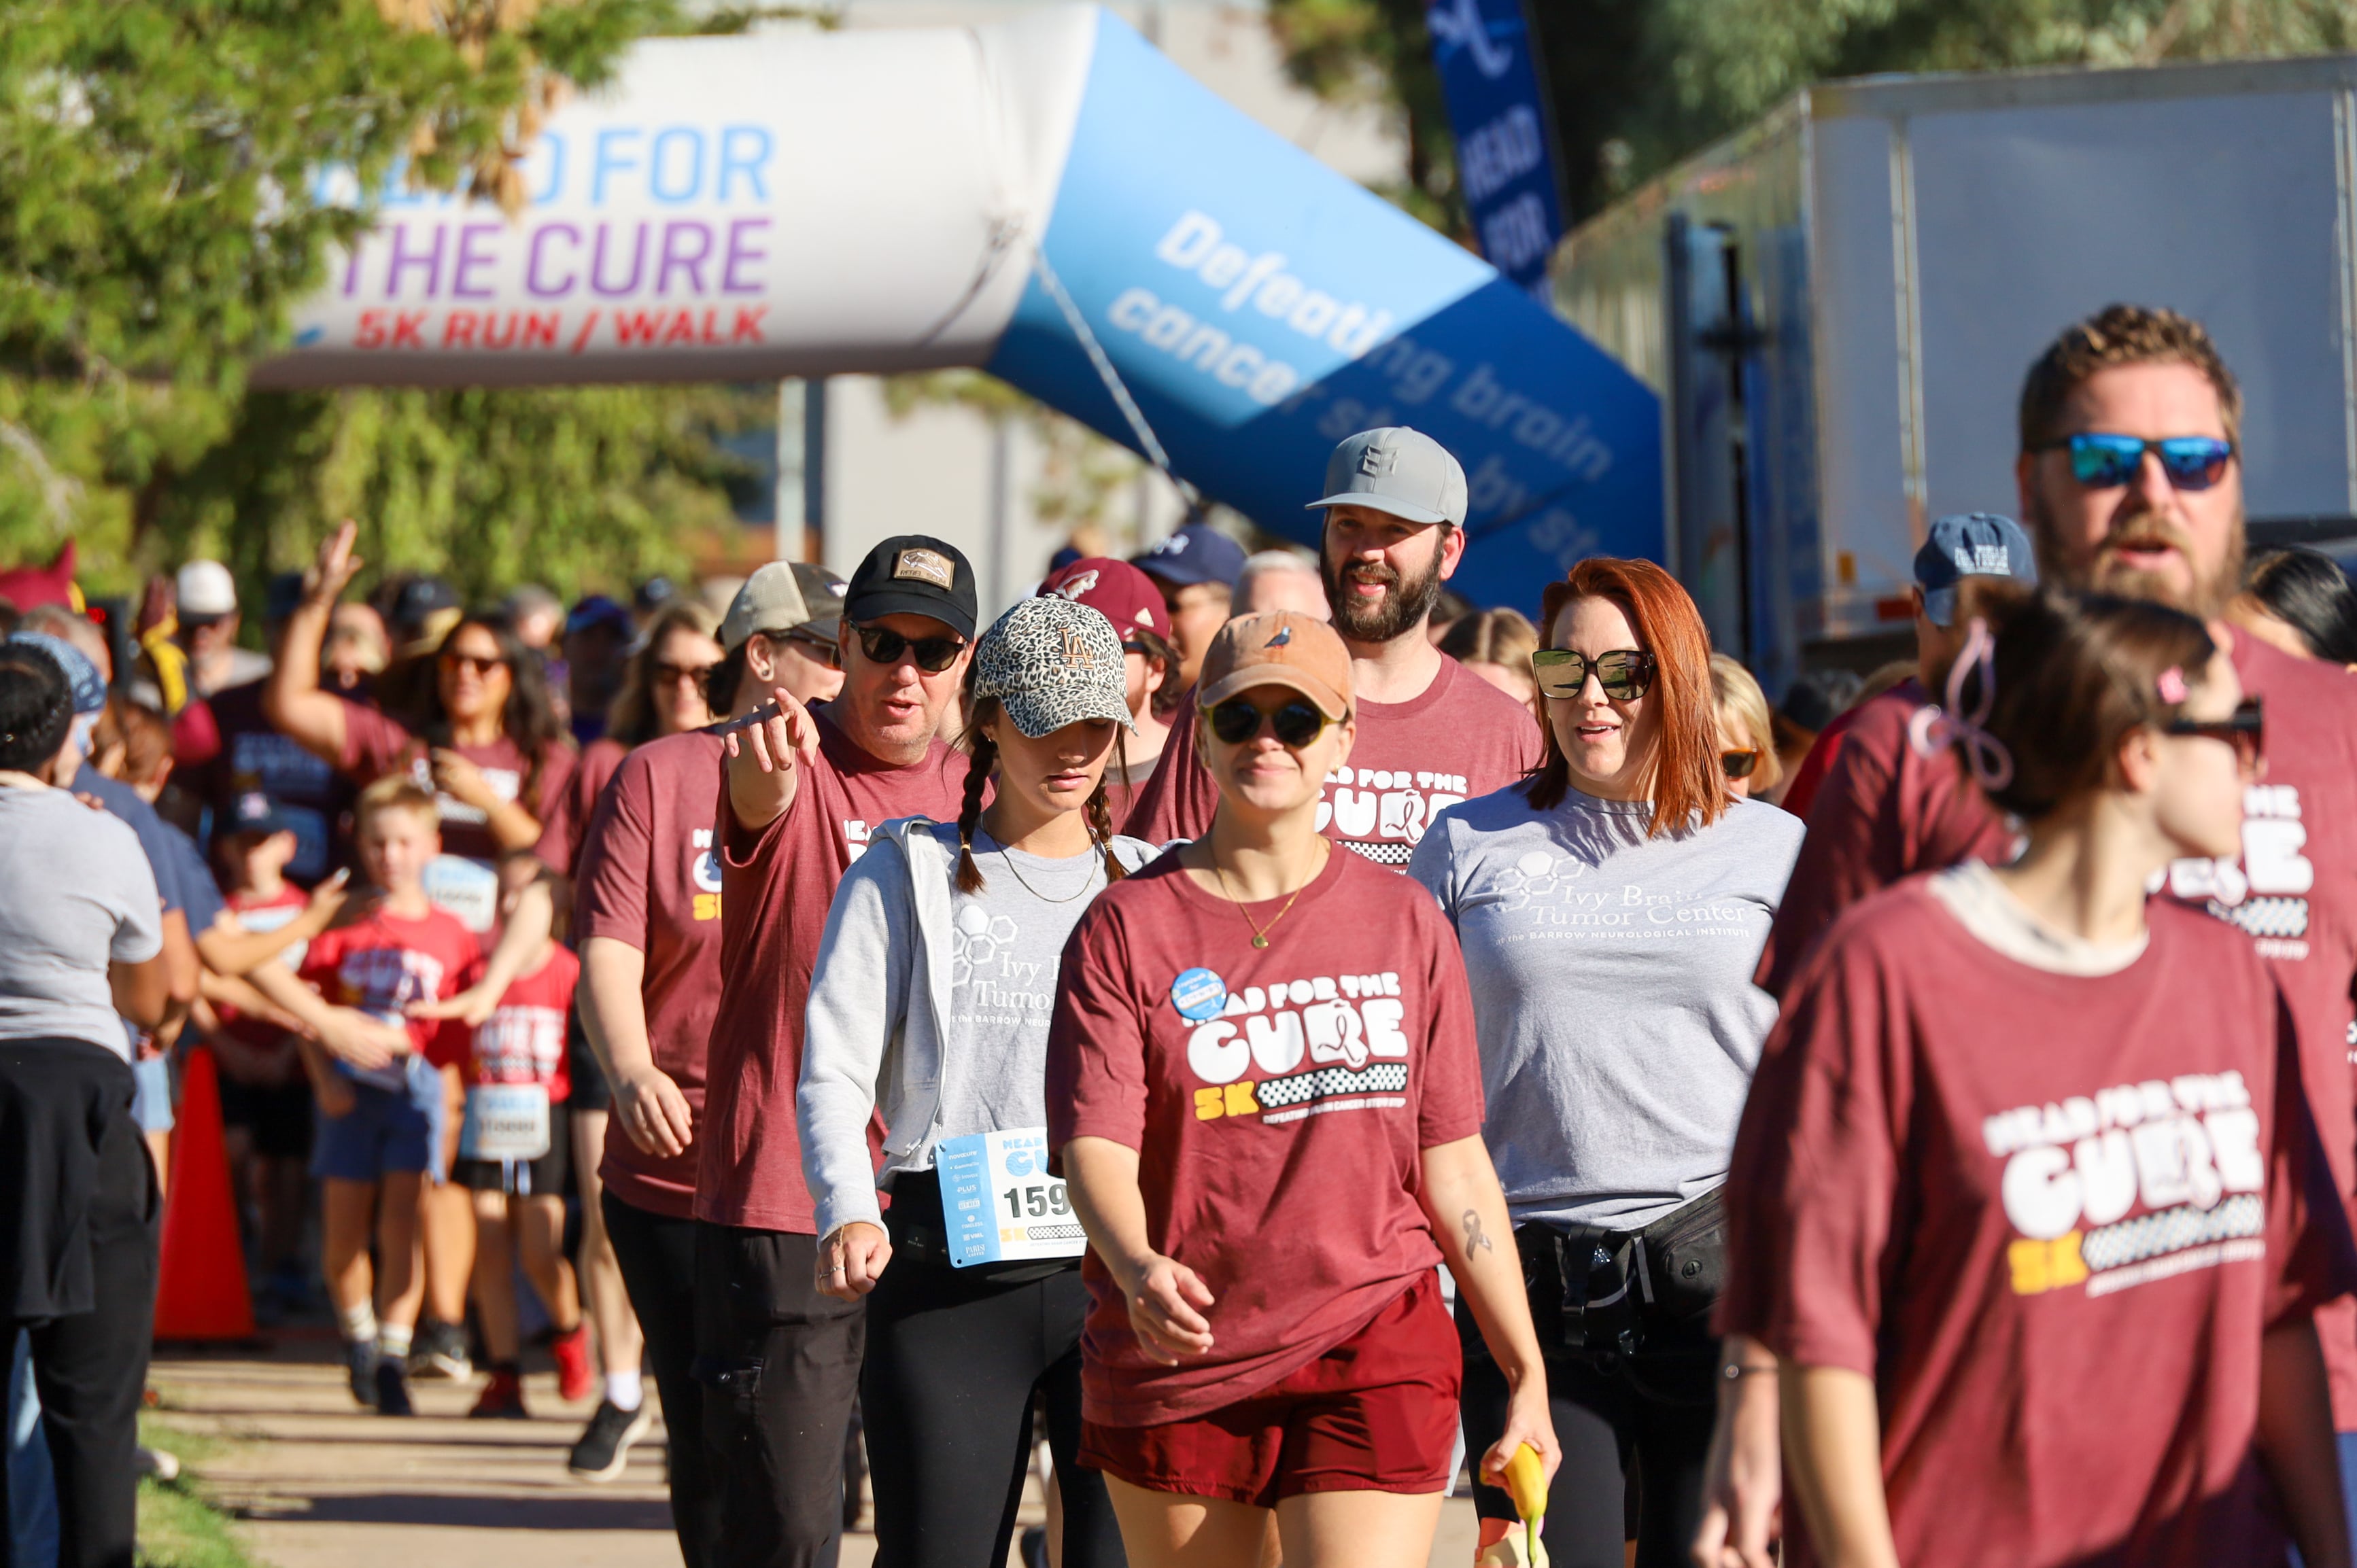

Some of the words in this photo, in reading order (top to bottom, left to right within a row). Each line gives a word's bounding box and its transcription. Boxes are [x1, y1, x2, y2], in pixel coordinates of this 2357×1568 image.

[590, 124, 776, 206] FOR
[342, 221, 503, 299] THE
[525, 217, 772, 299] CURE
[356, 311, 431, 349] 5K
[441, 310, 562, 349] RUN
[614, 306, 770, 347] WALK
[1156, 209, 1453, 405] Defeating
[1451, 363, 1615, 484] brain
[1107, 286, 1330, 412] cancer
[1358, 769, 1413, 790] FOR
[1416, 771, 1468, 794] THE
[1529, 905, 1634, 925] Tumor
[1647, 905, 1745, 924] Center
[1561, 886, 1610, 911] Ivy
[1508, 934, 1524, 943] the
[1530, 931, 1585, 939] BARROW
[1592, 929, 1691, 939] NEUROLOGICAL
[1697, 927, 1751, 938] INSTITUTE
[999, 951, 1042, 986] Ivy
[973, 979, 1055, 1011] Tumo
[1268, 976, 1339, 1009] FOR
[1339, 971, 1402, 999] THE
[958, 1014, 973, 1023] the
[975, 1015, 1022, 1025] BARROW
[1186, 997, 1409, 1085] CURE
[1193, 1080, 1260, 1121] 5K
[1982, 1095, 2099, 1157] HEAD
[2095, 1079, 2174, 1130] FOR
[2169, 1068, 2251, 1114] THE
[1003, 1137, 1044, 1149] HEAD
[957, 1184, 977, 1193] PLUS
[2001, 1106, 2265, 1241] CURE
[999, 1227, 1028, 1243] 5K
[2008, 1228, 2090, 1296] 5K
